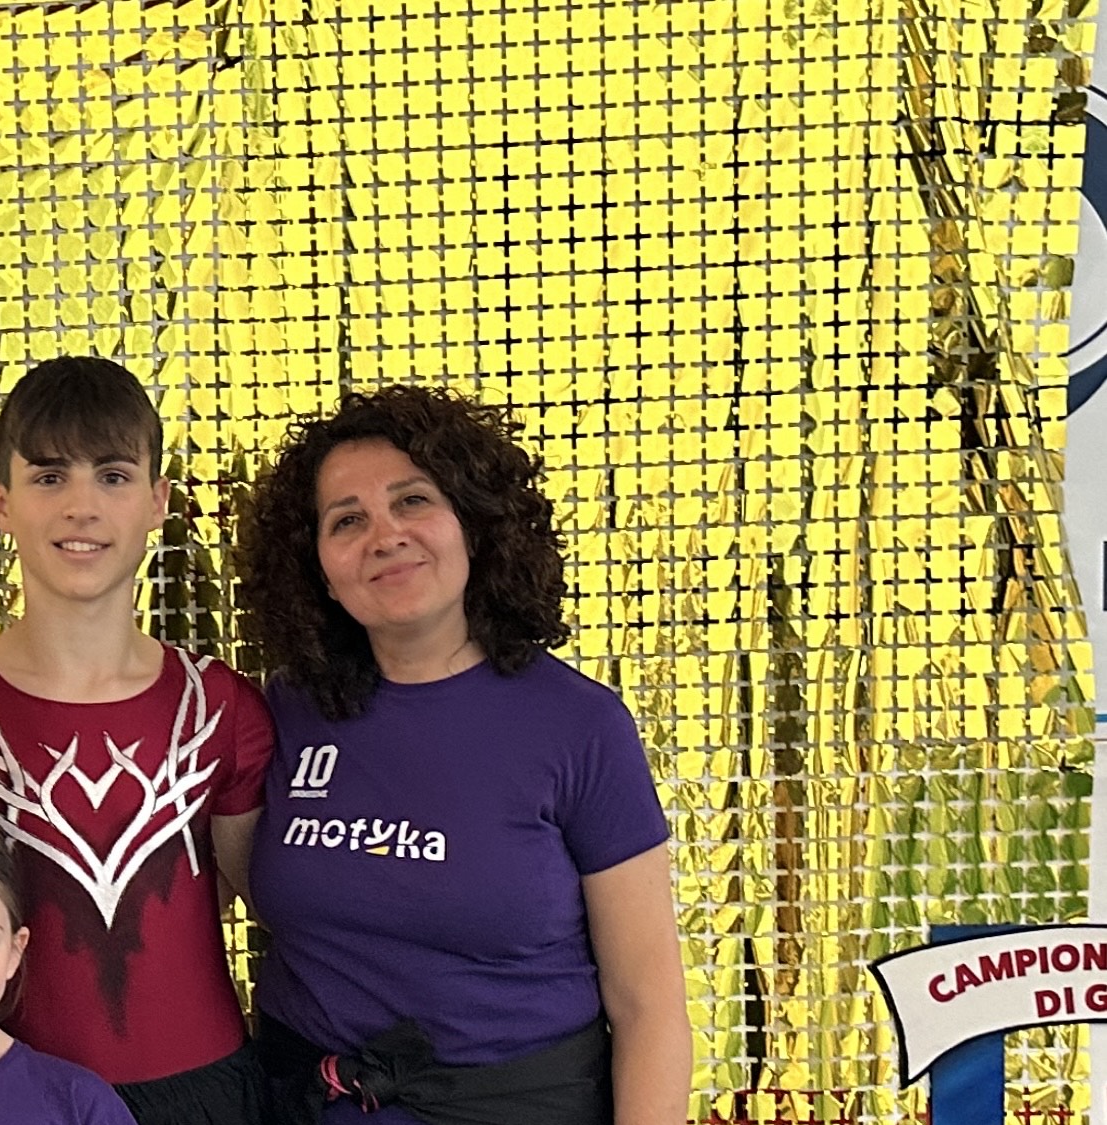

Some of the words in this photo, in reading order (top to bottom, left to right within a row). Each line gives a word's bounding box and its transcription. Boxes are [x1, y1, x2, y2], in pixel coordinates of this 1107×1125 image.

[290, 744, 339, 788] 10
[283, 816, 446, 861] motyka
[928, 943, 1107, 1003] CAMPION
[1034, 986, 1076, 1018] DI
